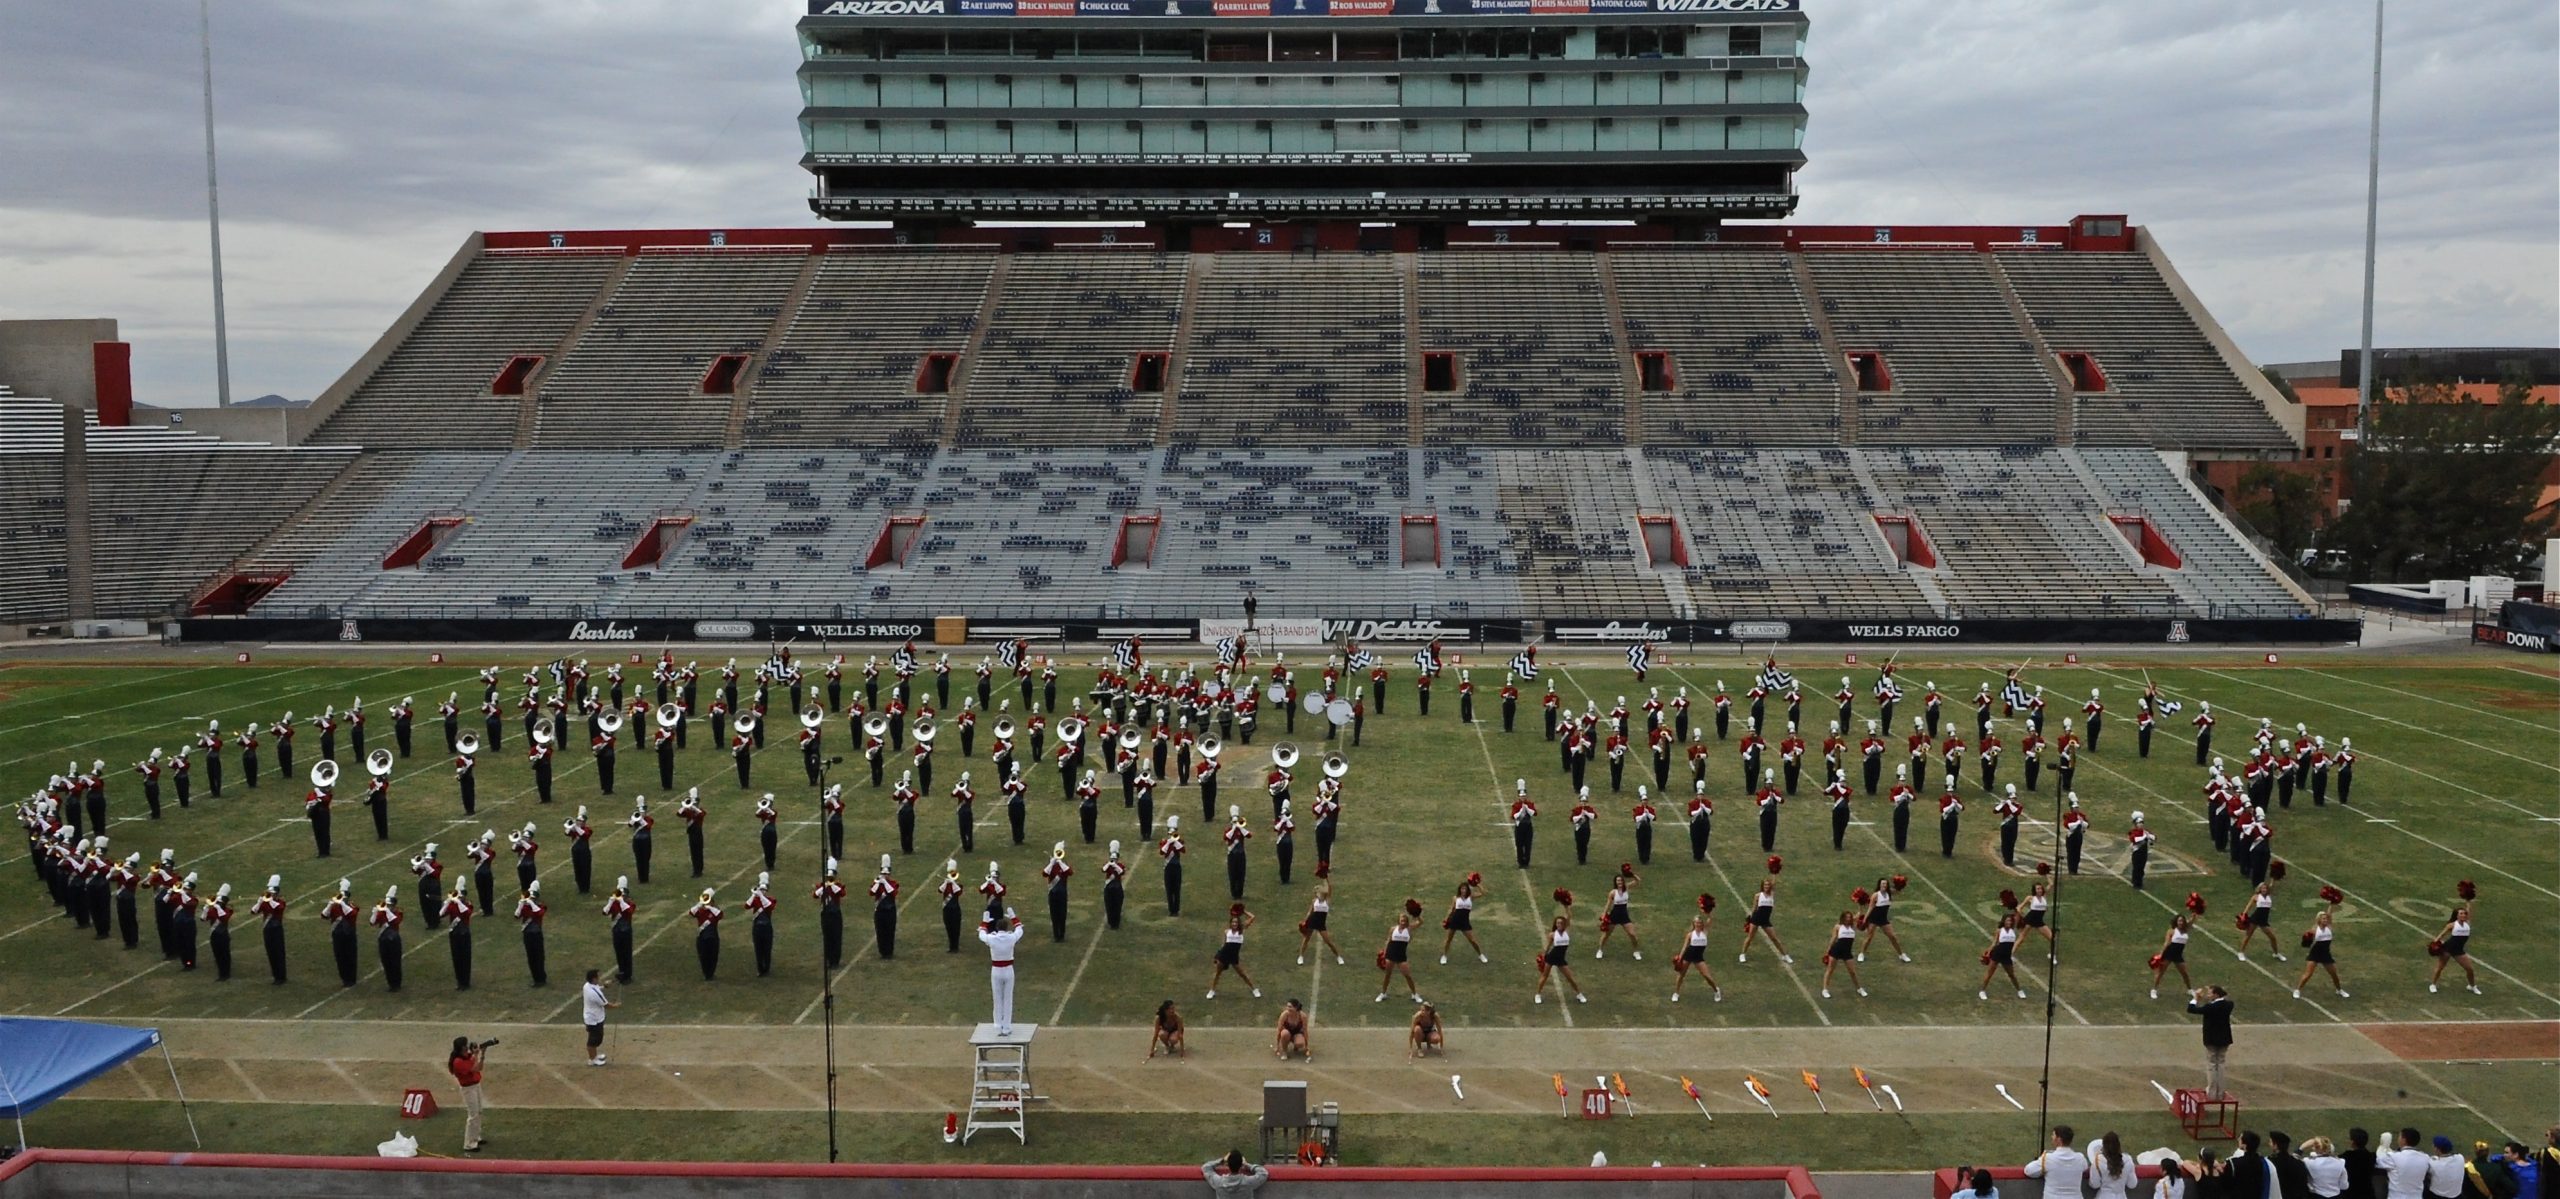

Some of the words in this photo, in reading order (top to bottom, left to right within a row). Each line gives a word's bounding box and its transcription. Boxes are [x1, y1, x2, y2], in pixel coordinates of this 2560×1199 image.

[822, 1, 945, 14] ARIZONA
[961, 1, 970, 10] 22
[970, 2, 983, 10] ART
[984, 2, 1014, 10] LUPPINO
[1026, 2, 1047, 10] RICKY
[1048, 2, 1074, 10] HUNLEY
[1086, 2, 1109, 10] CHUCK
[1213, 2, 1218, 10] 4
[1656, 0, 1790, 11] WILDCATS
[712, 237, 724, 246] 18
[896, 235, 907, 244] 19
[1102, 234, 1116, 243] 20
[1259, 233, 1271, 243] 21
[1495, 234, 1508, 243] 22
[1705, 233, 1718, 242] 23
[1876, 234, 1889, 243] 24
[2022, 234, 2036, 243] 25
[552, 238, 562, 247] 17
[171, 413, 182, 422] 16
[340, 620, 361, 640] A
[569, 620, 638, 640] Bashas'
[715, 625, 749, 633] CASINOS
[811, 625, 866, 636] WELLS
[869, 625, 922, 636] FARGO
[1203, 624, 1240, 637] UNIVERSITY
[1284, 625, 1303, 636] BAND
[1304, 625, 1319, 636] DAY
[1750, 626, 1786, 634] CASINOS
[1848, 625, 1903, 636] WELLS
[1907, 625, 1960, 636] FARGO
[2167, 621, 2190, 641] A
[404, 1093, 423, 1114] 40
[1587, 1094, 1605, 1114] 40
